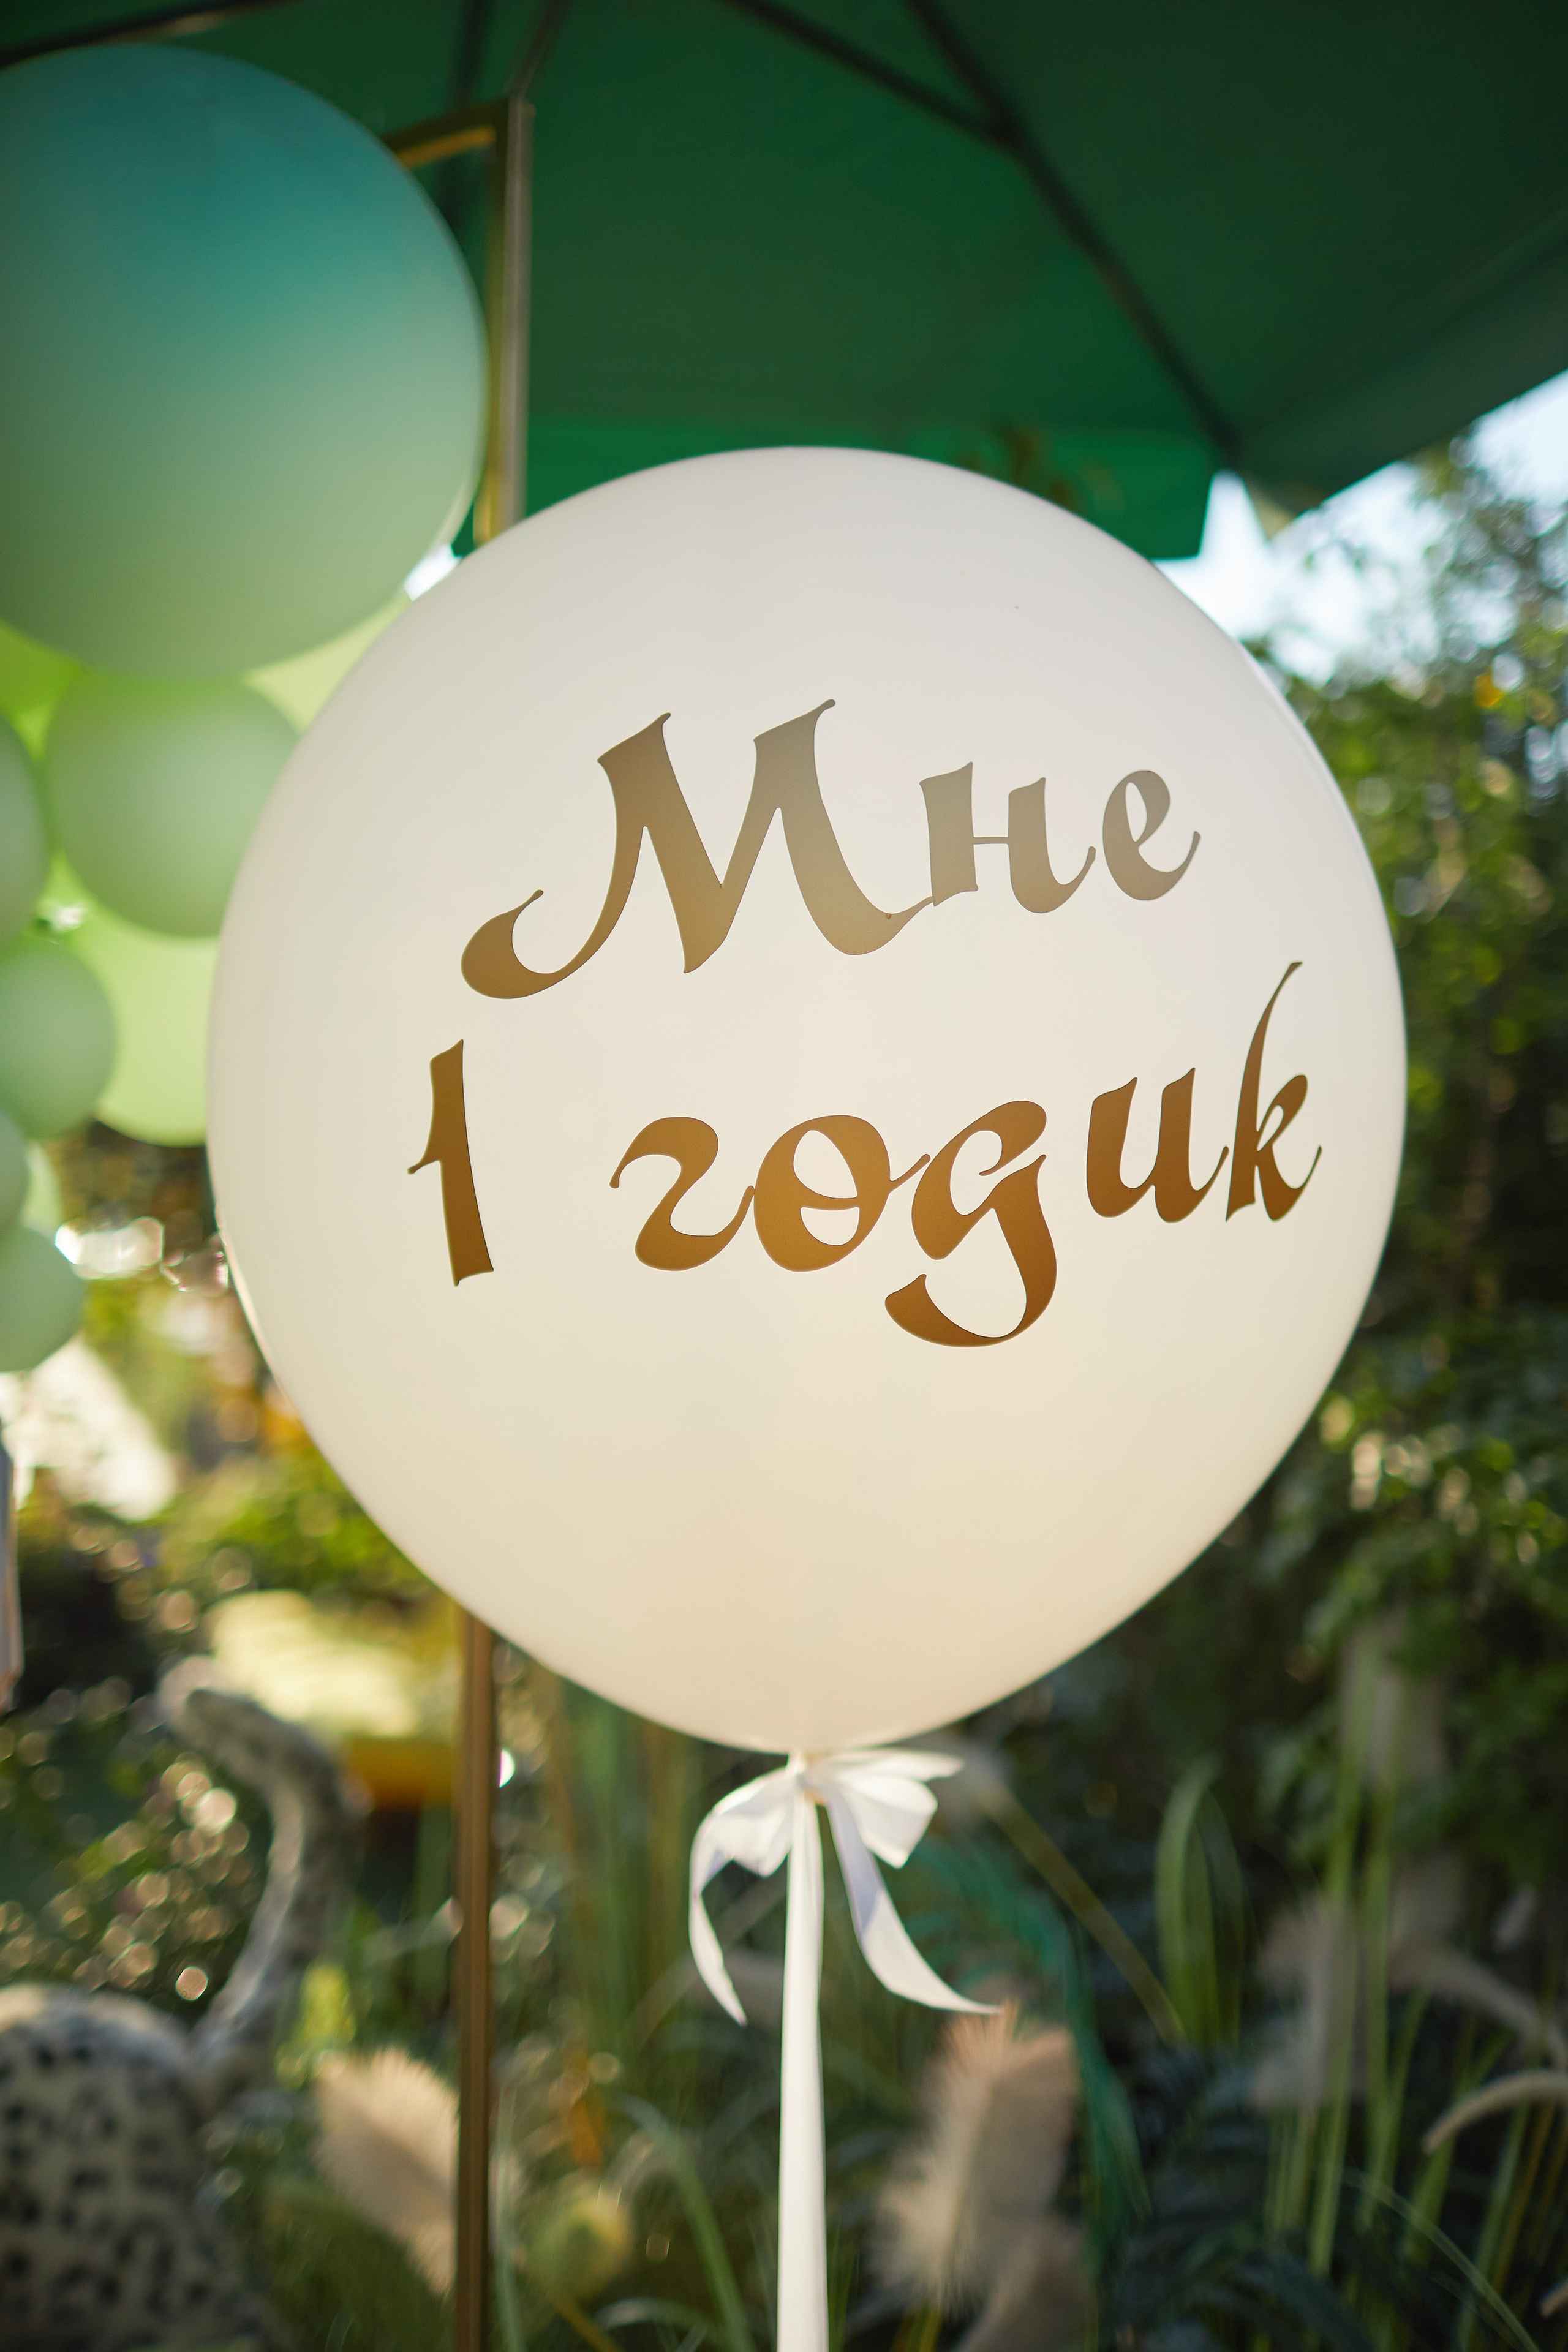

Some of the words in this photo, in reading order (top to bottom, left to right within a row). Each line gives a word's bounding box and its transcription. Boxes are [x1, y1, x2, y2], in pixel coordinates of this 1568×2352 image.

[460, 699, 1201, 1000] Мне
[407, 1038, 495, 1287] 1
[609, 960, 1323, 1348] годик
